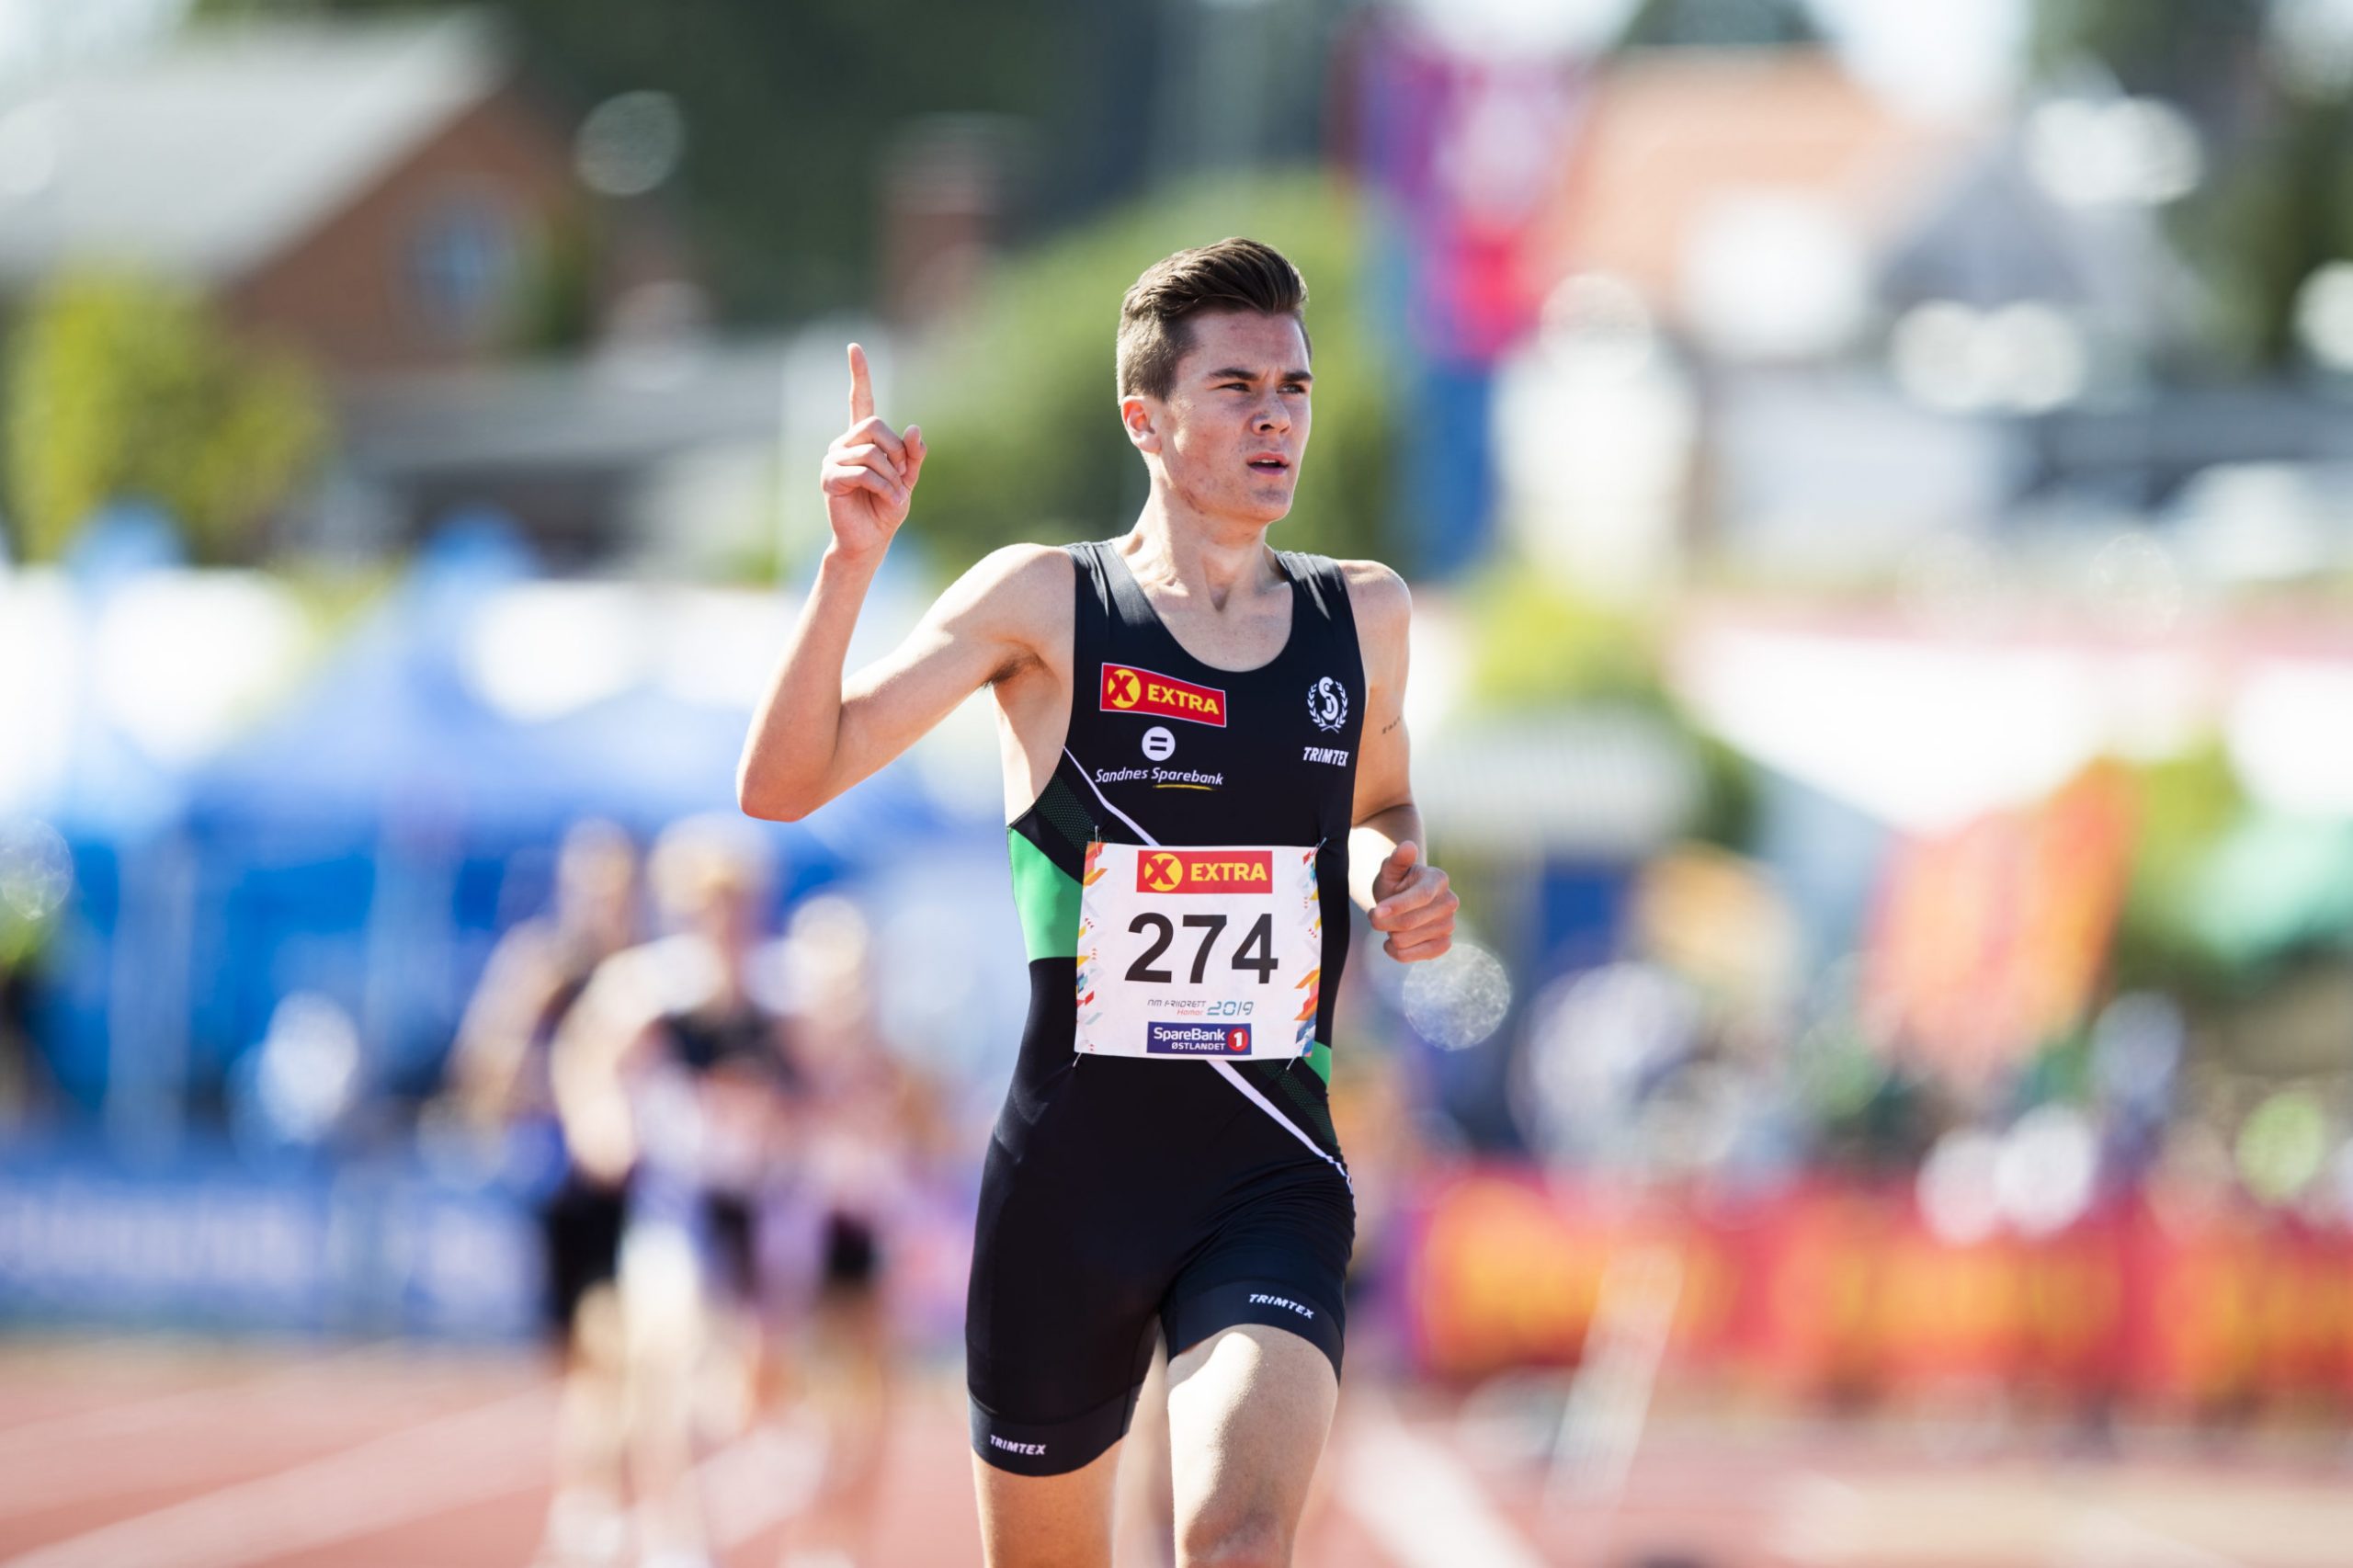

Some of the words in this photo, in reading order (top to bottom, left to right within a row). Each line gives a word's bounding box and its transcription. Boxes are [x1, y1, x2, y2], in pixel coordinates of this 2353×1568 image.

[1148, 684, 1219, 714] EXTRA
[1302, 746, 1348, 767] TRIMTEX
[1095, 767, 1148, 782] Sandnes
[1151, 767, 1224, 786] Sparebank
[1190, 862, 1267, 881] EXTRA
[1124, 912, 1279, 984] 274
[1207, 1001, 1254, 1016] 2019
[1154, 1027, 1225, 1042] SpareBank
[1171, 1041, 1225, 1051] ØSTLANDET
[1250, 1293, 1314, 1320] TRIMTEX
[990, 1435, 1047, 1456] TRIMTEX
